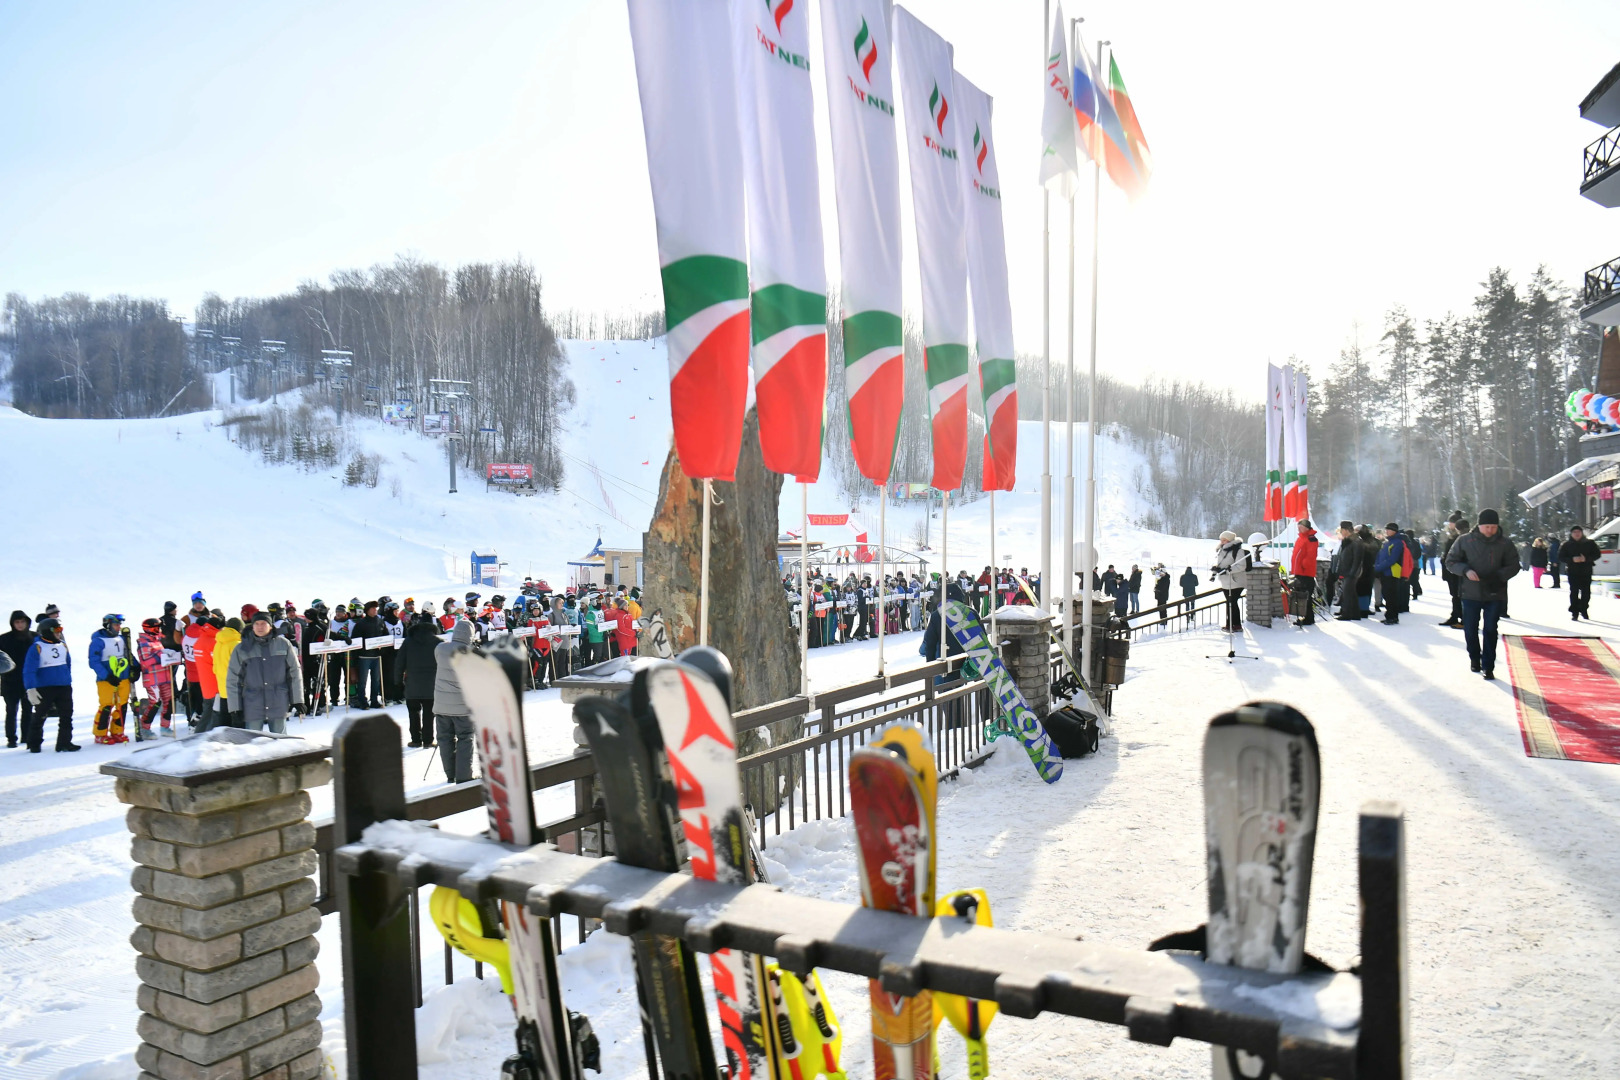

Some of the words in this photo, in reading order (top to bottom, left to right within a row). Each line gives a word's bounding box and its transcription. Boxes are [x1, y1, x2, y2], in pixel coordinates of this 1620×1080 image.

[812, 516, 846, 525] FINISH
[391, 627, 401, 636] 13
[114, 641, 120, 652] 1
[51, 647, 60, 659] 3
[938, 600, 1064, 779] PHANTOM
